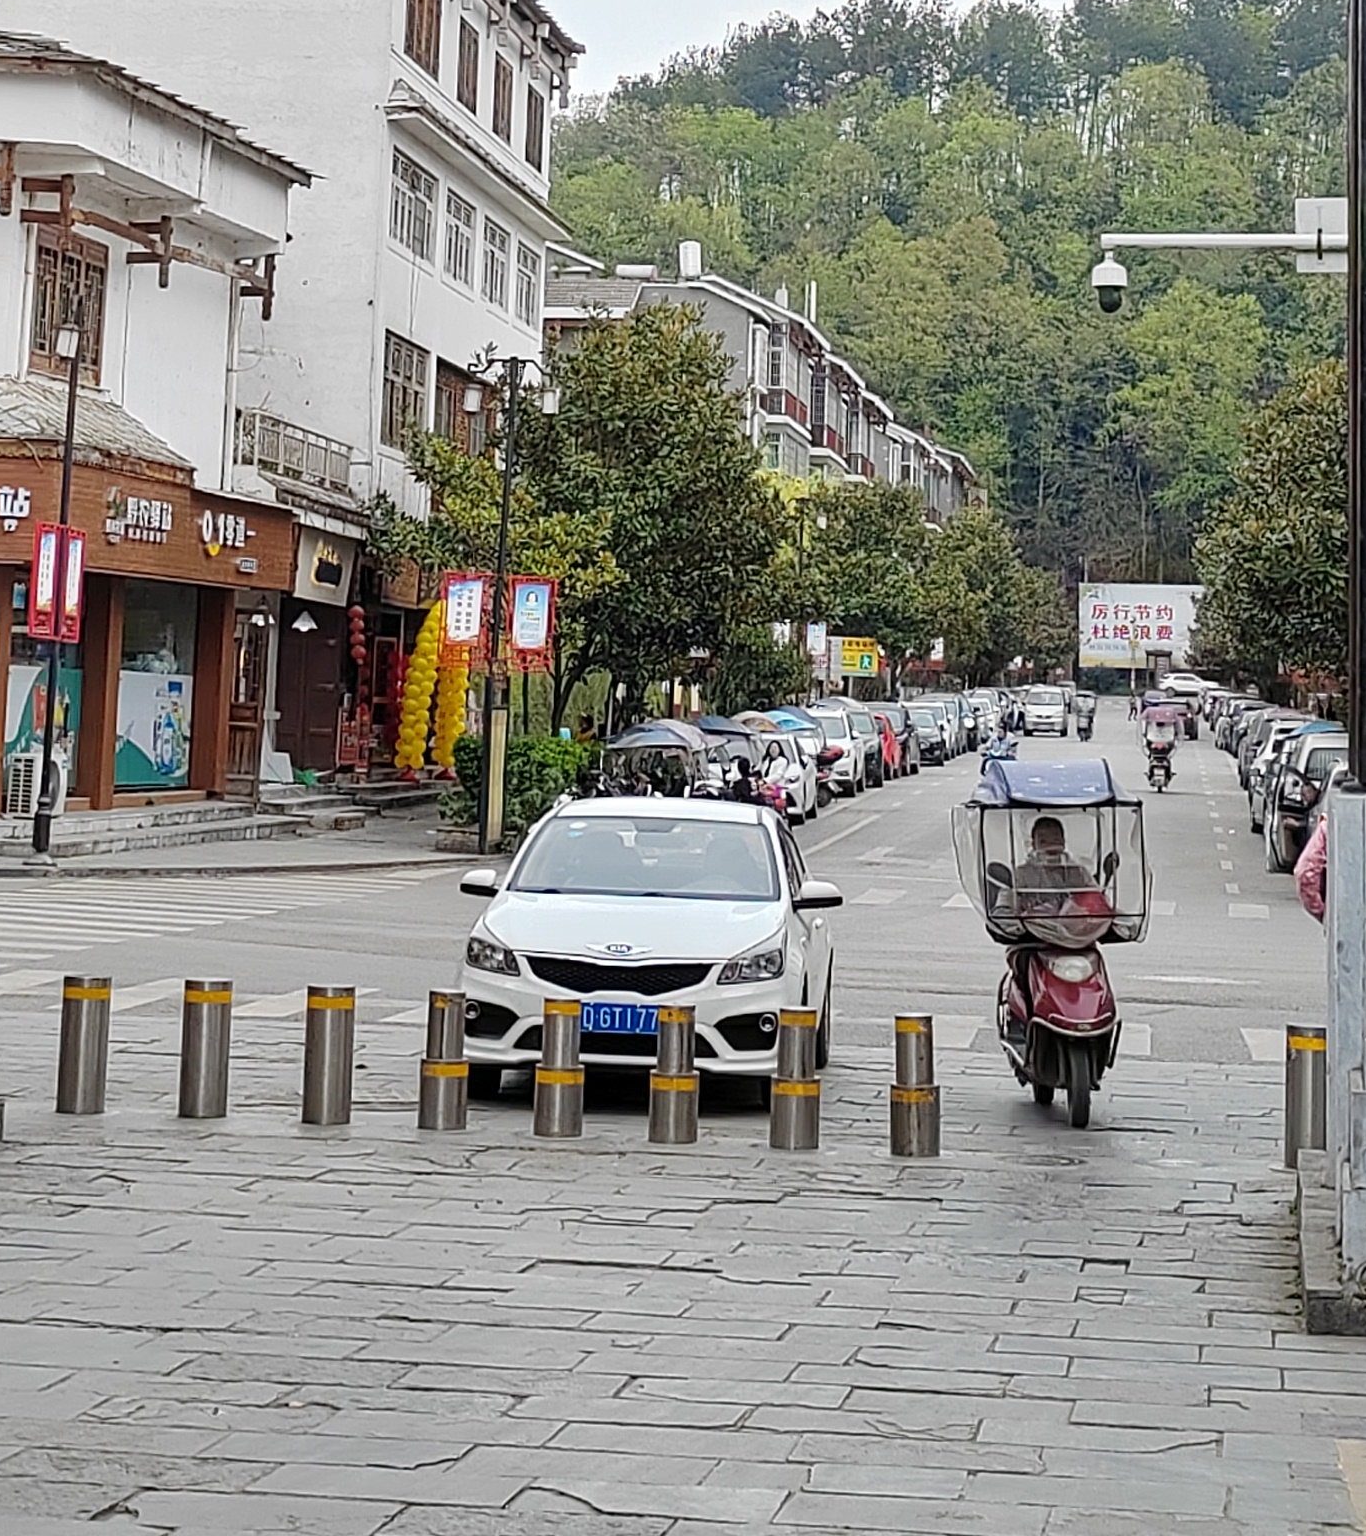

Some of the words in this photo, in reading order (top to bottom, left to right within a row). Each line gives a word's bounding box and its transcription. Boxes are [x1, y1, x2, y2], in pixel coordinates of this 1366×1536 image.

[1091, 604, 1173, 621] 厉行节约
[1091, 624, 1173, 641] 杜绝浪费
